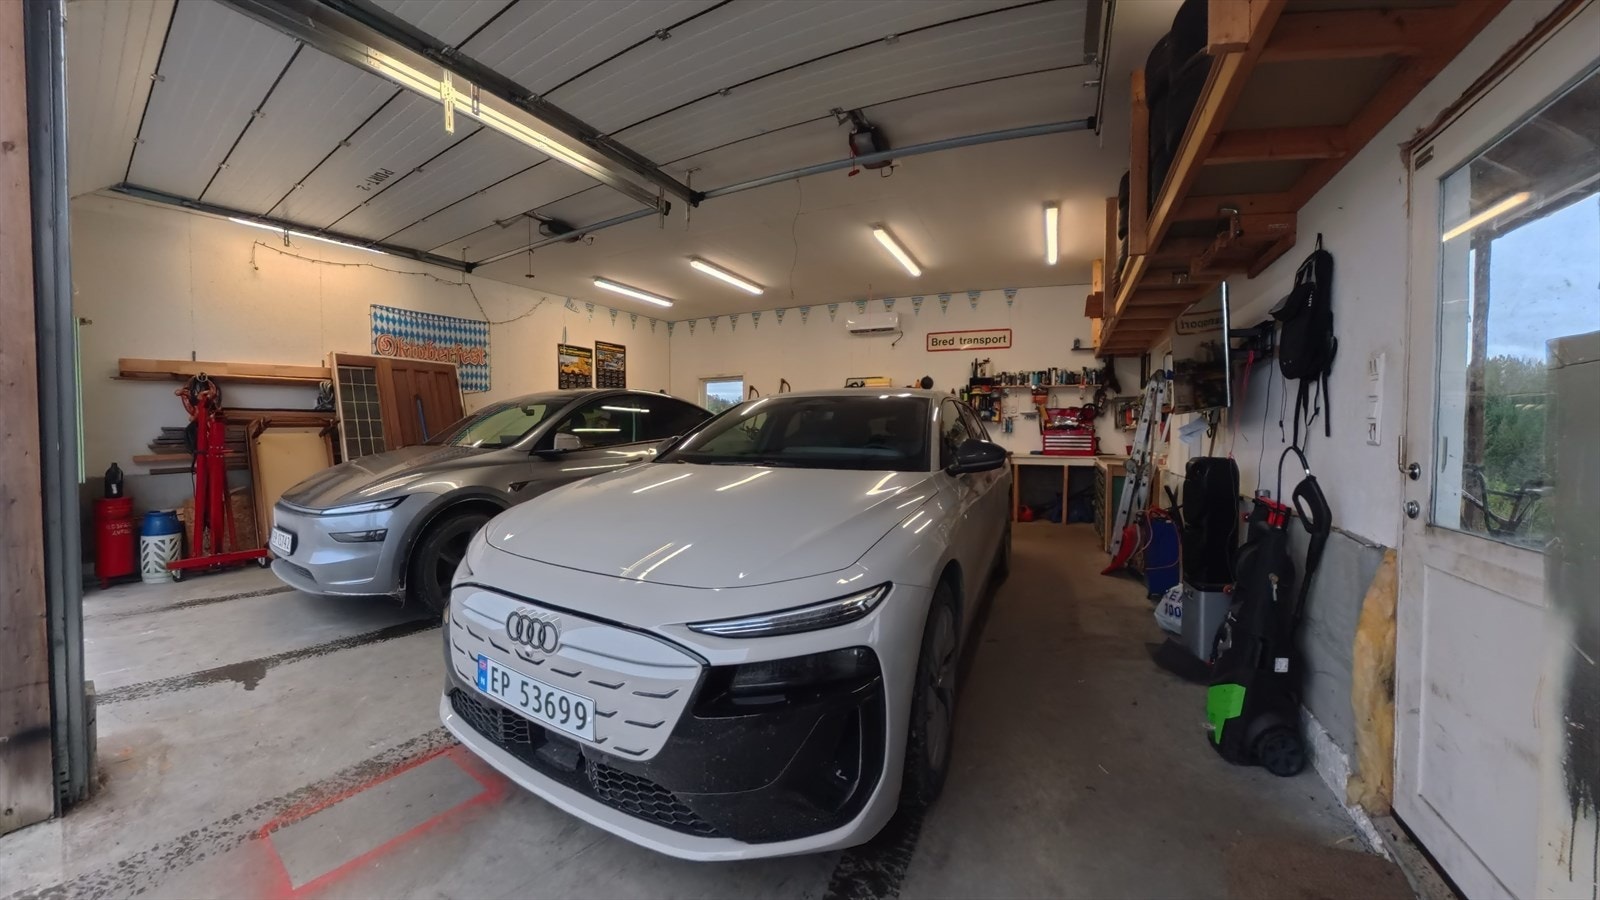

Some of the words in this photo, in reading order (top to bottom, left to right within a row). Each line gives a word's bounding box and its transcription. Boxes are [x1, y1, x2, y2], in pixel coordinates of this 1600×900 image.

[376, 334, 486, 366] Oktoberfest
[931, 337, 955, 347] Bred
[960, 335, 1007, 345] transport
[491, 666, 510, 696] EP
[520, 680, 587, 730] 53699
